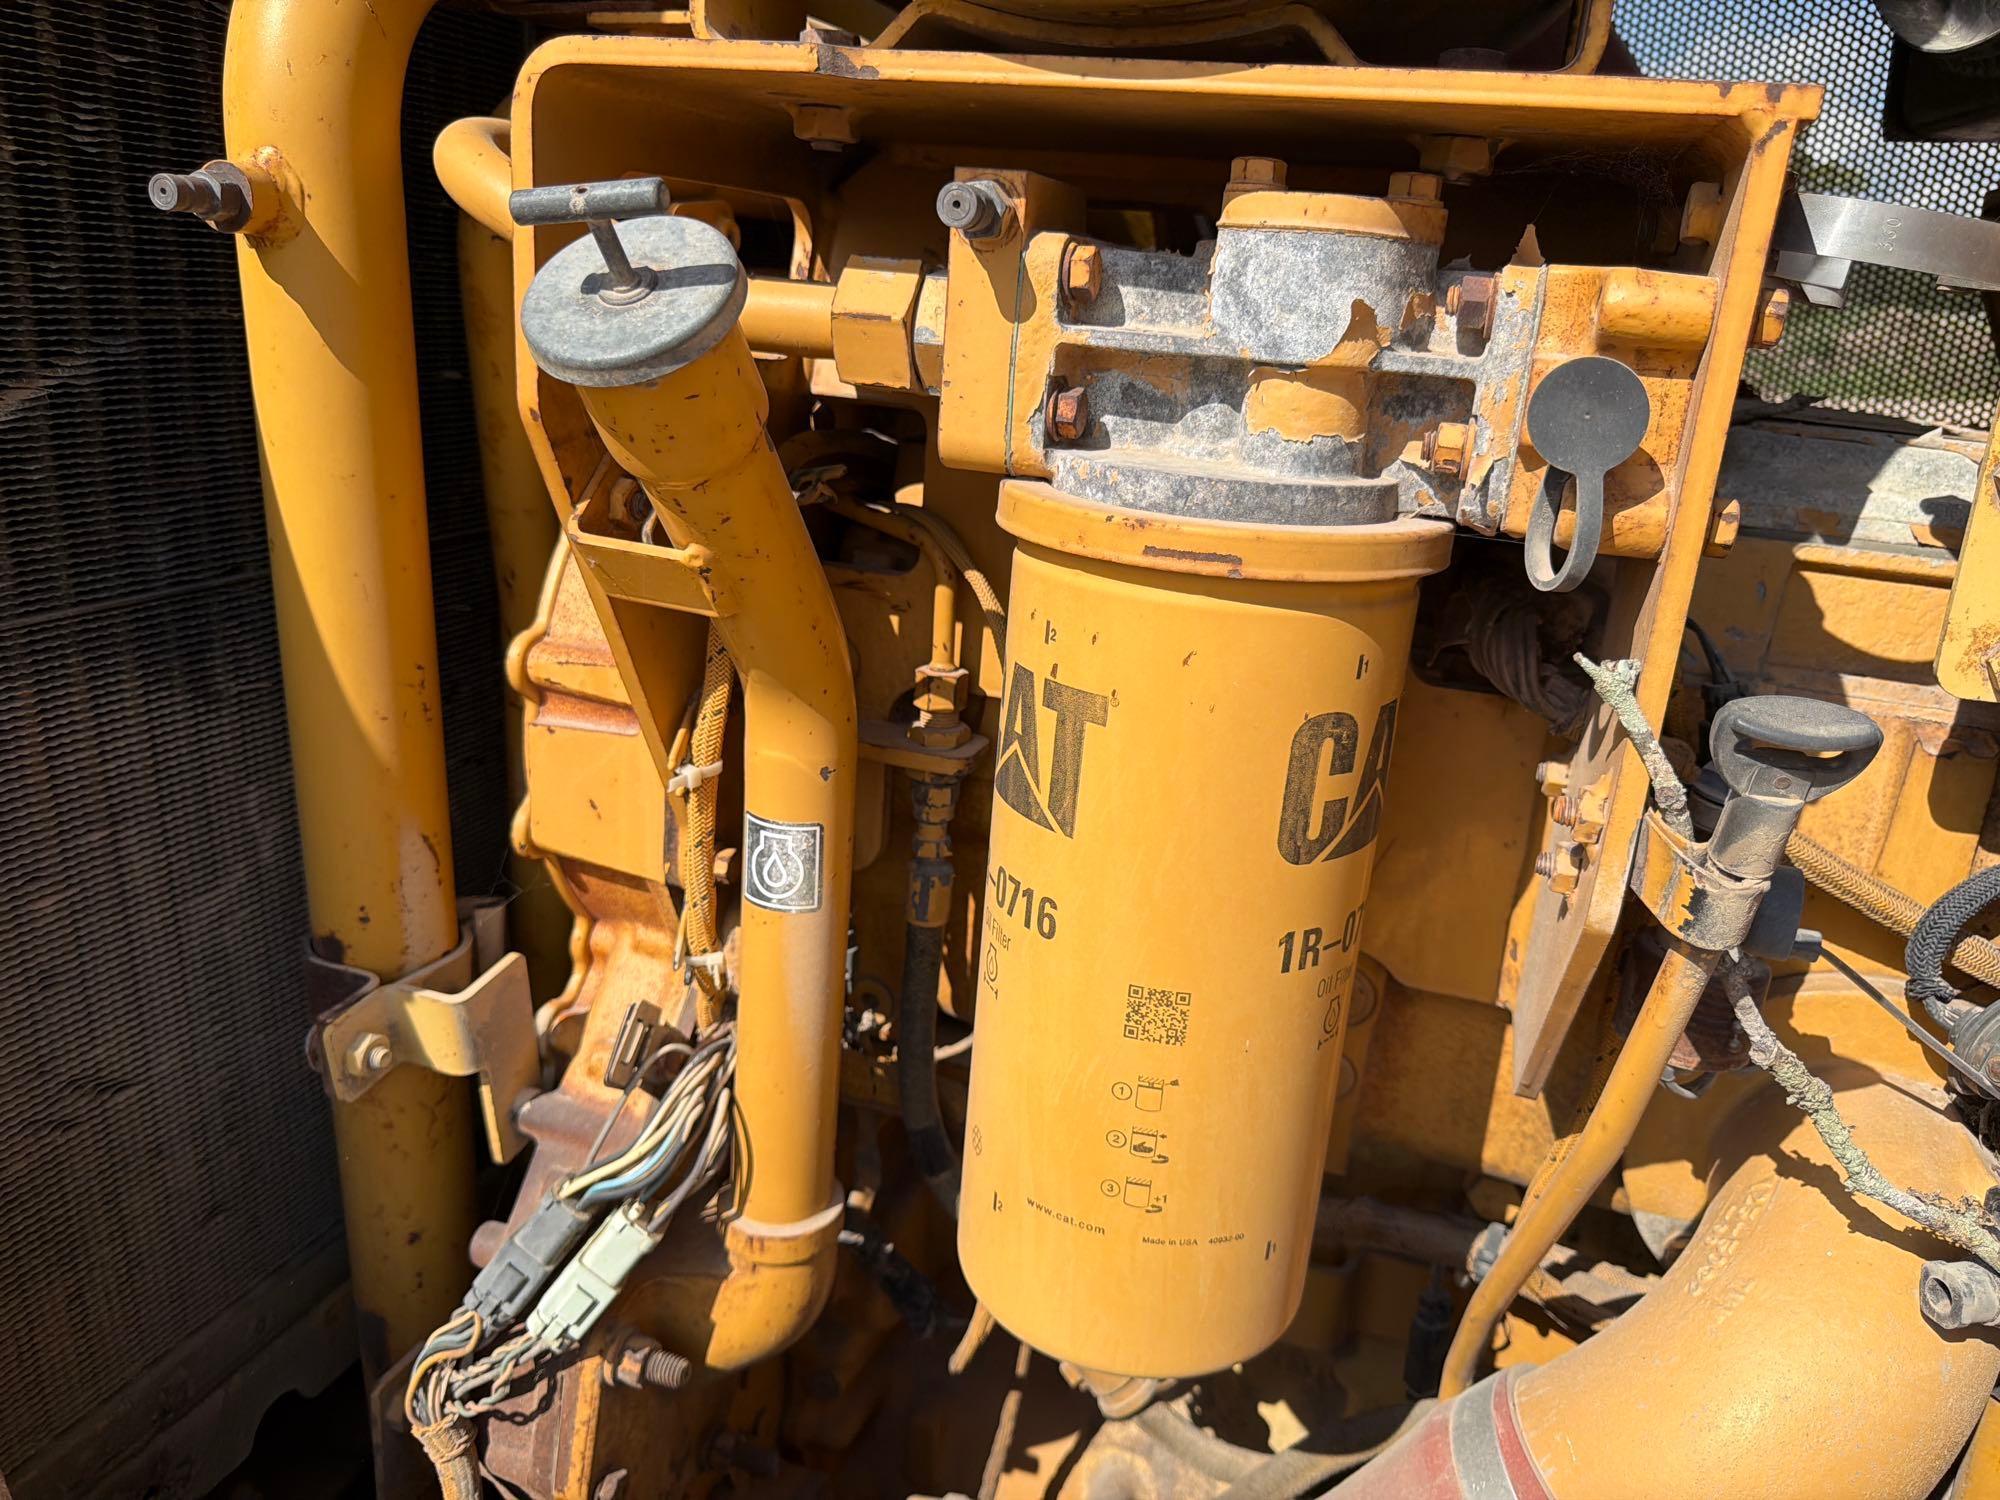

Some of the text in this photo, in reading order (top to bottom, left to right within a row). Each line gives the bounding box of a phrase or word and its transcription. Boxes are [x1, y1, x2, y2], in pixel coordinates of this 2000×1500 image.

[995, 662, 1109, 839] AT
[1277, 698, 1398, 866] CA
[989, 866, 1058, 940] -0716
[992, 918, 1011, 951] Filter
[1279, 901, 1364, 974] 1R-07
[1317, 975, 1333, 999] Oil
[1026, 1197, 1105, 1235] www.cat.com
[1142, 1236, 1166, 1246] Made
[1168, 1238, 1177, 1246] in
[1179, 1239, 1199, 1247] USA
